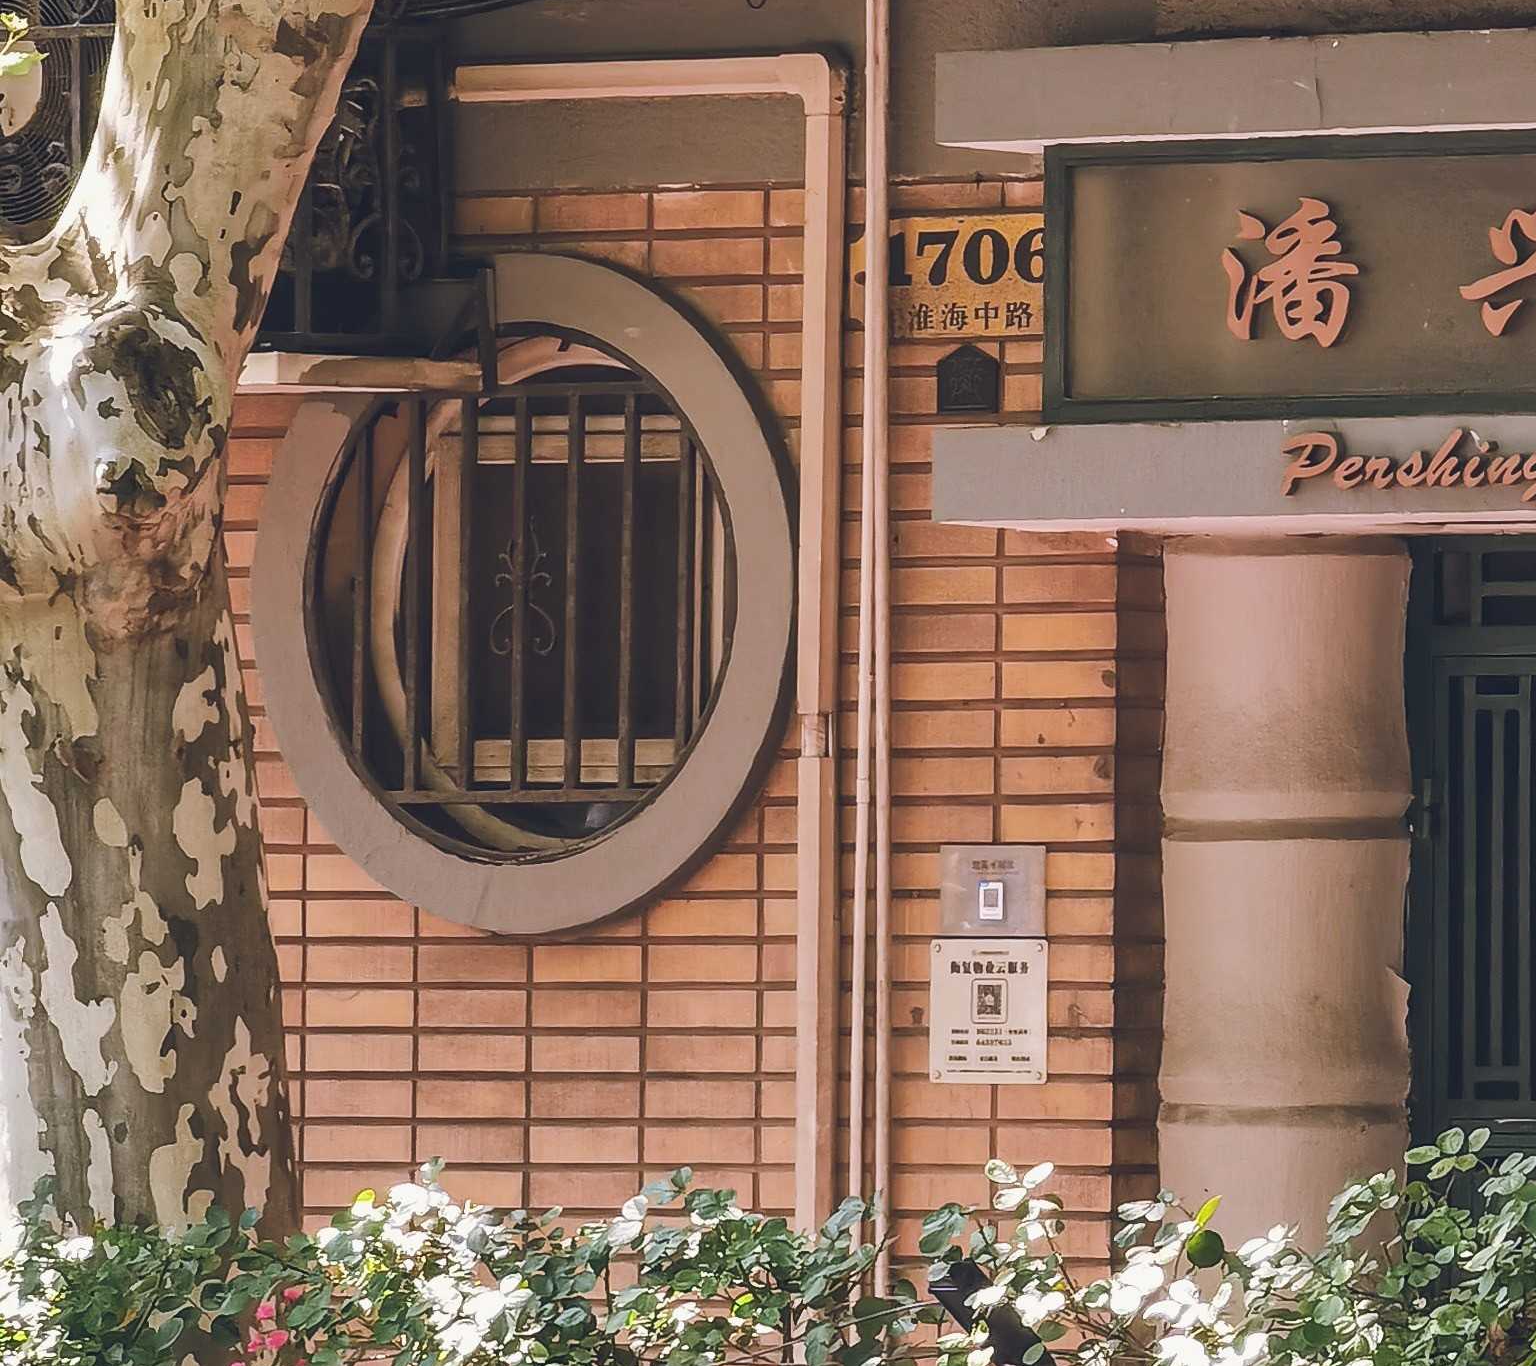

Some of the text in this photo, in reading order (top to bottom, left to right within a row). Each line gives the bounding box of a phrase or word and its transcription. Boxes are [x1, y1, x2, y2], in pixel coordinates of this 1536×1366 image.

[888, 227, 1044, 286] 1706
[908, 301, 1034, 332] 淮海中路
